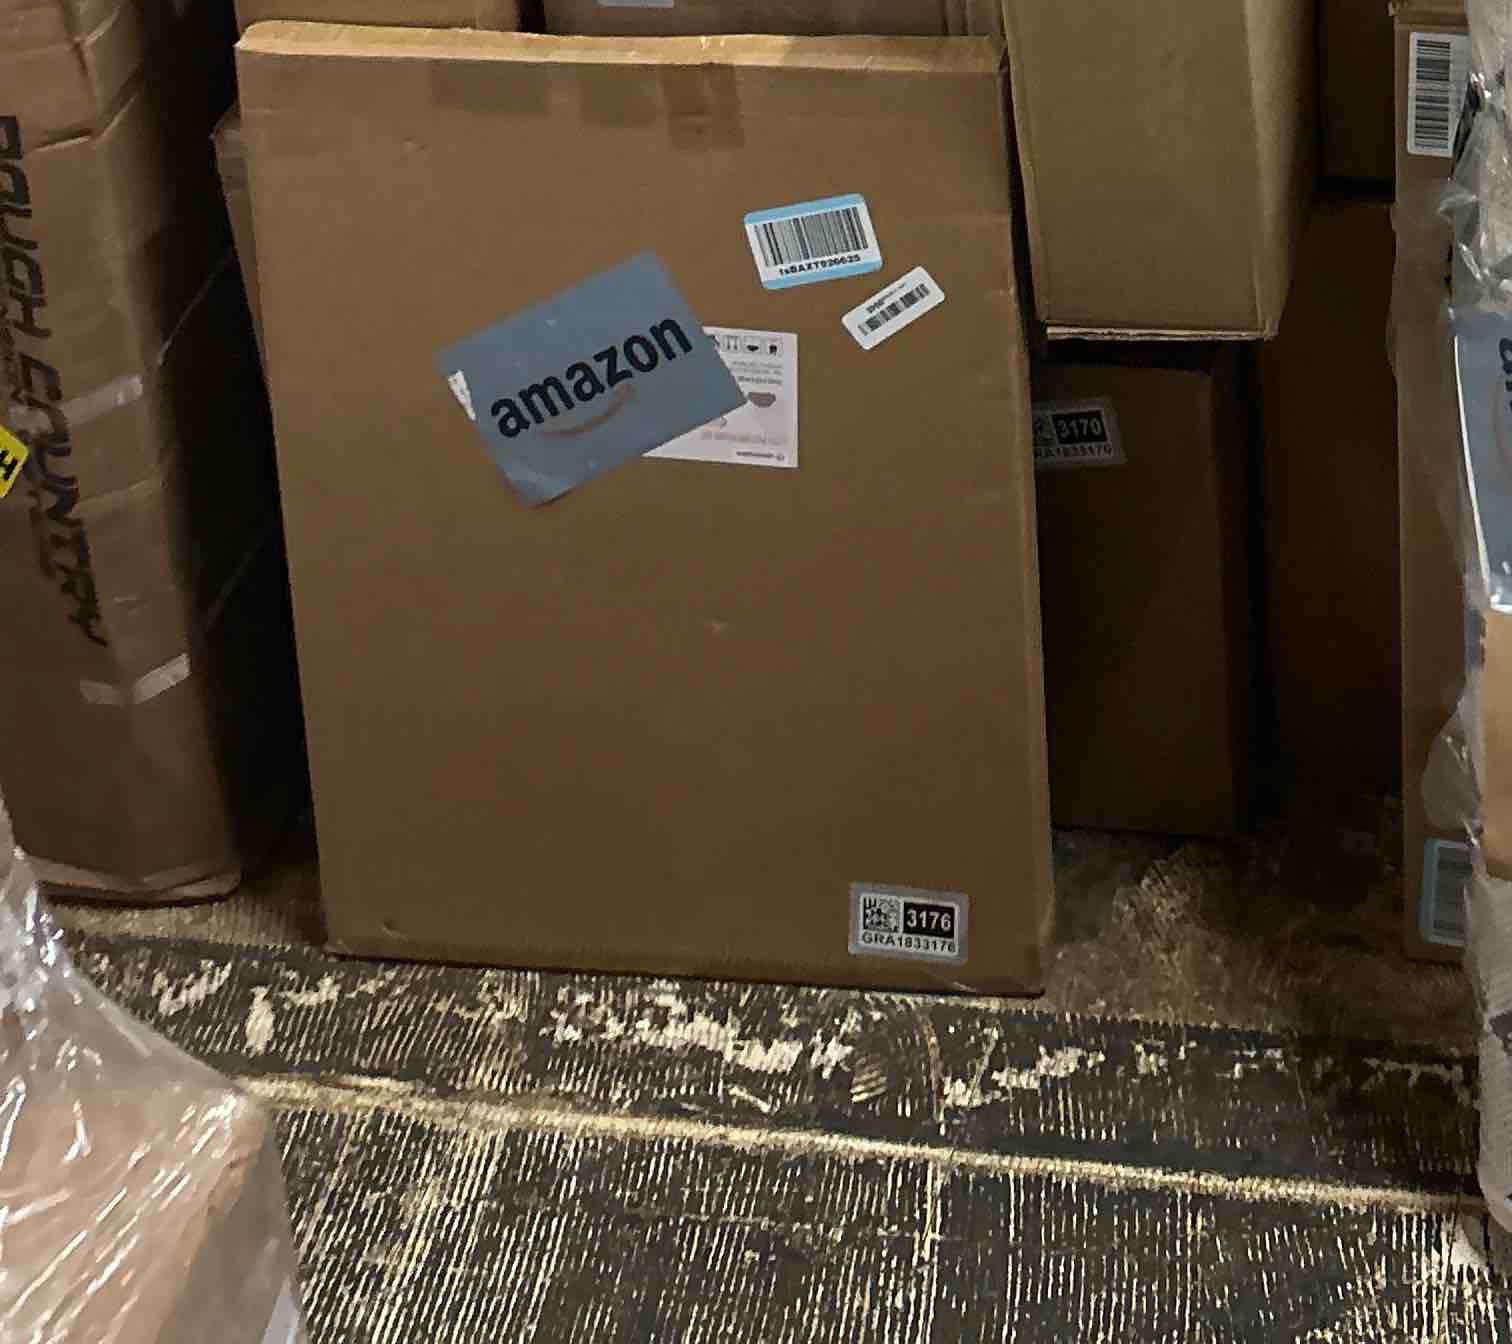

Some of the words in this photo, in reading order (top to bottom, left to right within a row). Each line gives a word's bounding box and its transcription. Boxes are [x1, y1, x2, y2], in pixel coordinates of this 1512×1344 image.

[490, 313, 694, 440] amazon
[1055, 417, 1102, 442] 3170
[905, 909, 954, 933] 3176
[861, 931, 956, 954] GRA1833176
